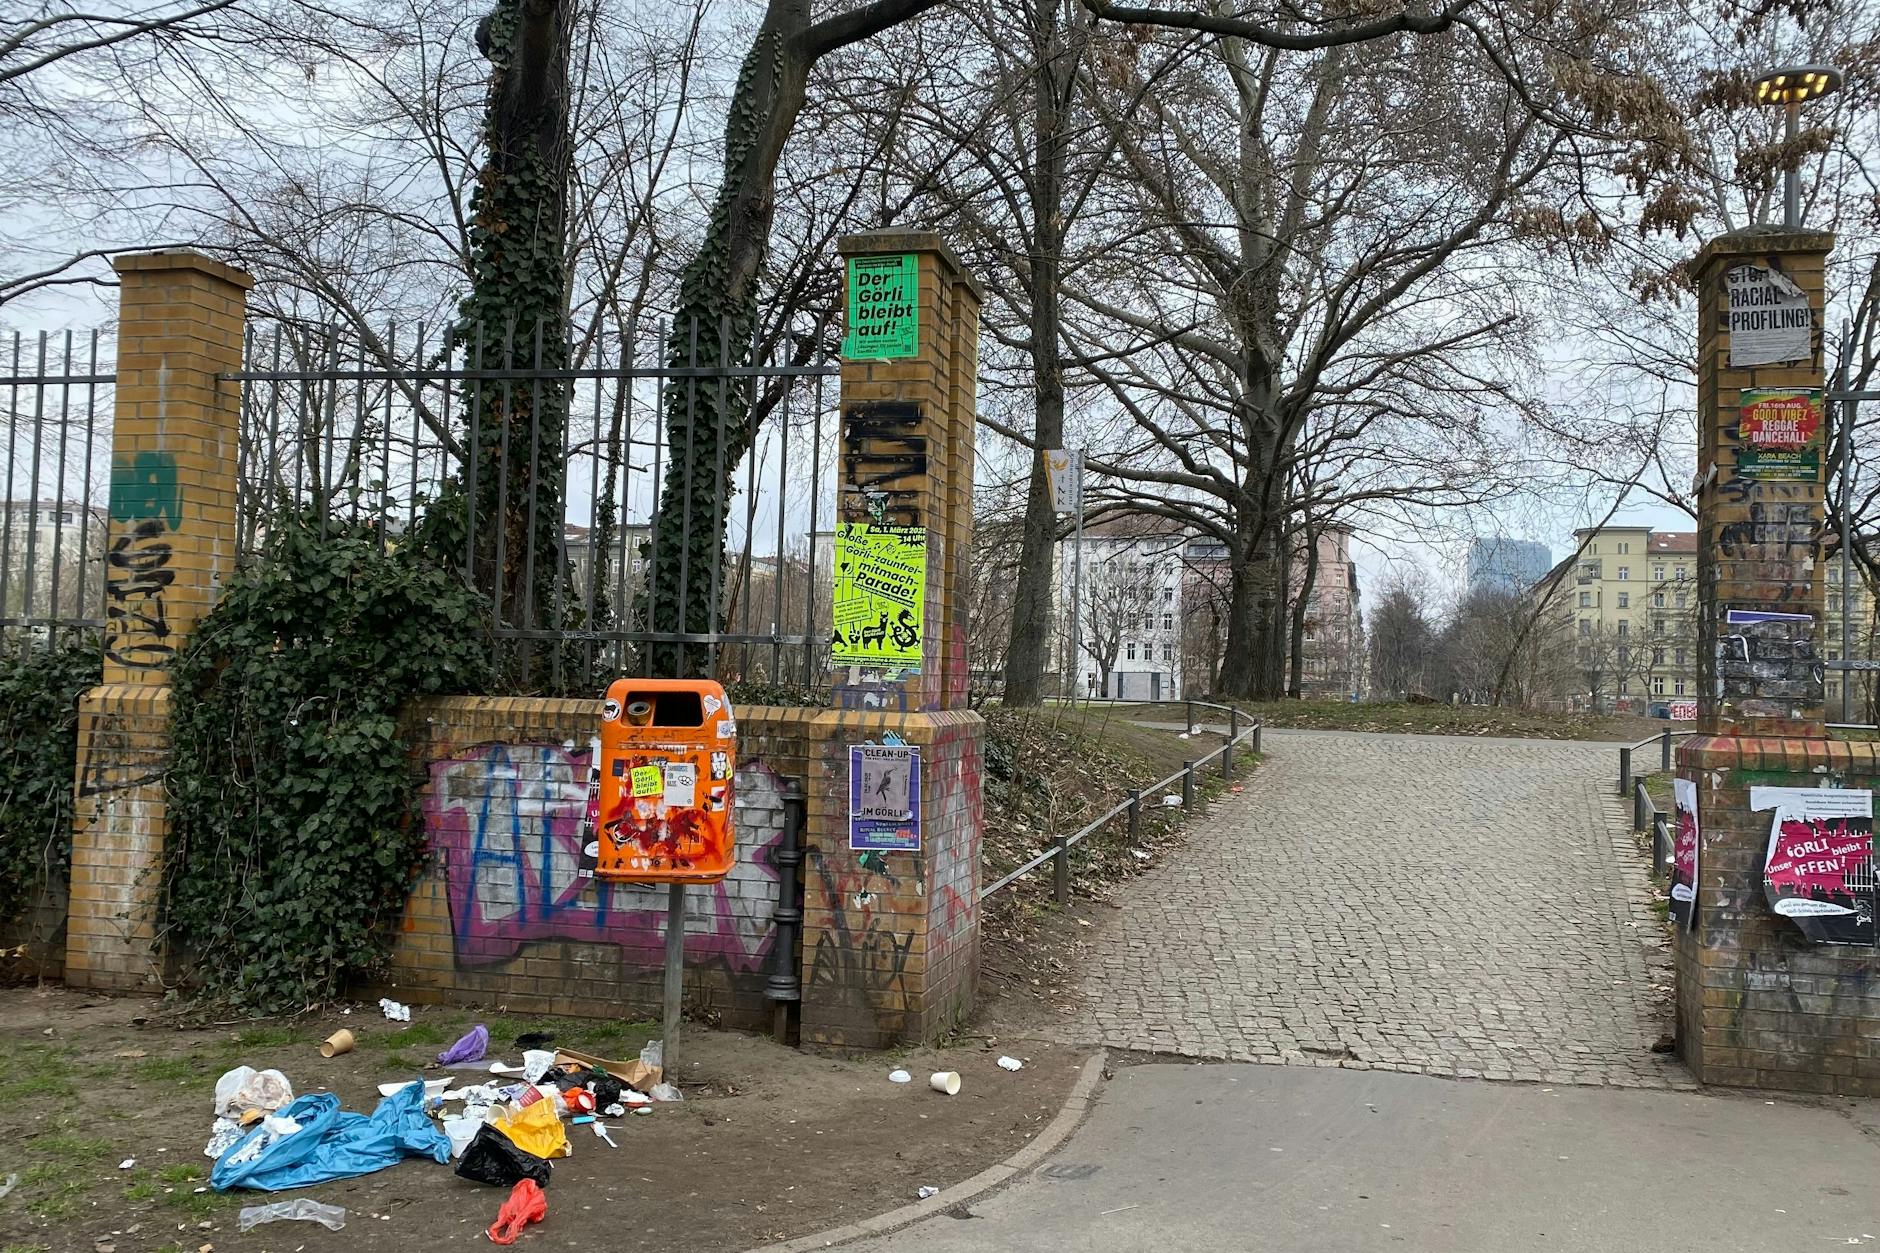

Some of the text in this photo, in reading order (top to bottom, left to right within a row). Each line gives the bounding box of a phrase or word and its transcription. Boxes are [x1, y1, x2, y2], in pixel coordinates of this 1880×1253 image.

[858, 273, 890, 286] Der
[859, 286, 903, 302] Görli
[1731, 287, 1782, 307] RACIAL
[858, 303, 912, 320] bleibt
[1731, 308, 1809, 331] PROFILING!
[858, 320, 897, 337] auf!
[1752, 409, 1808, 421] GOOD VIBEZ
[1762, 420, 1799, 432] REGGAE
[1752, 431, 1807, 443] DANCEHALL
[870, 526, 881, 534] Sa,
[890, 526, 908, 534] März
[837, 530, 869, 546] Große
[858, 562, 919, 585] mitmach-
[855, 571, 917, 599] Parade!
[865, 749, 909, 758] CLEAN-UP
[636, 781, 658, 789] bleibt
[863, 807, 873, 816] IM
[1831, 842, 1861, 856] bleibt
[1767, 861, 1793, 874] Unser
